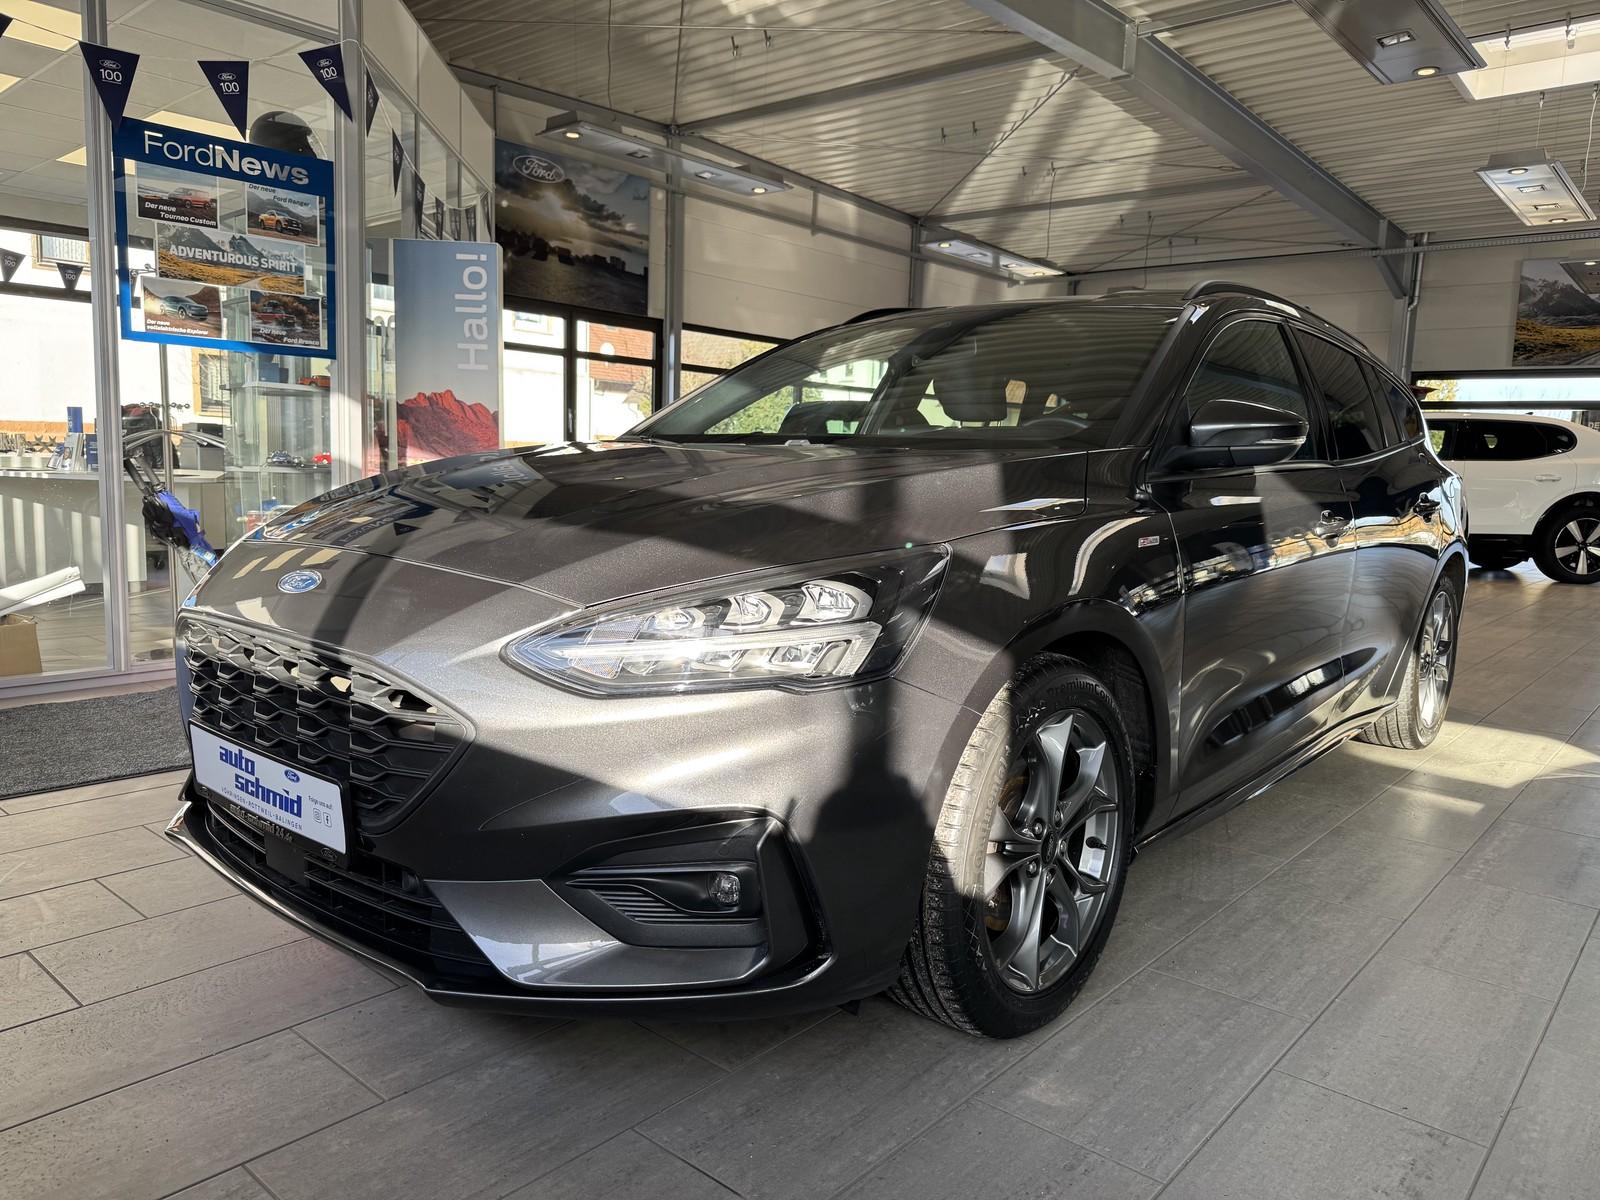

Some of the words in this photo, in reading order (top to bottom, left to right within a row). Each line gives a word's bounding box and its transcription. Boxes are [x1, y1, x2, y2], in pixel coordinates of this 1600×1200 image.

[99, 69, 122, 82] 100
[320, 67, 337, 78] 100
[219, 82, 240, 92] 100
[143, 130, 310, 185] FordNews
[521, 157, 557, 181] Ford
[144, 201, 158, 209] Der
[272, 195, 287, 203] Ford
[287, 198, 310, 207] Ranger
[160, 211, 189, 222] Tourneo
[189, 216, 217, 226] Custom
[169, 243, 260, 268] ADVENTUROUS
[260, 257, 298, 273] SPIRIT
[454, 253, 489, 370] Hallo!
[283, 336, 298, 344] Ford
[219, 745, 256, 777] auto
[234, 773, 303, 819] schmid
